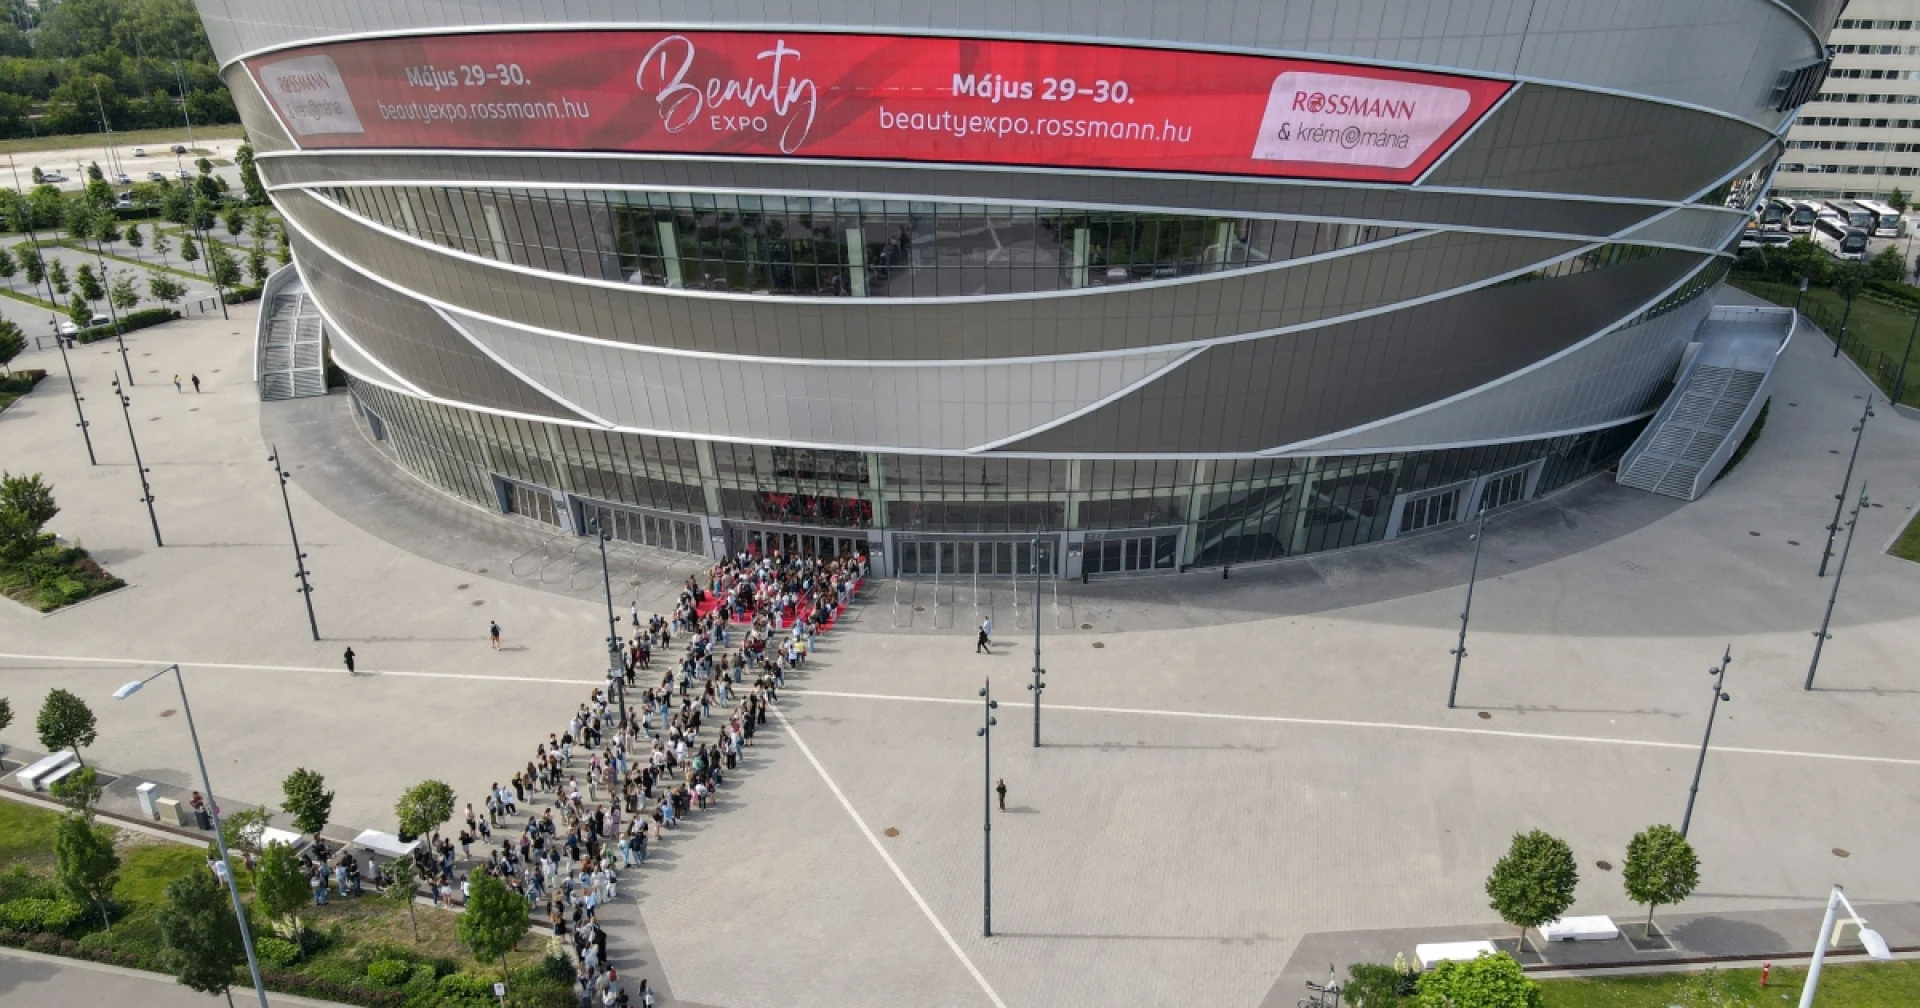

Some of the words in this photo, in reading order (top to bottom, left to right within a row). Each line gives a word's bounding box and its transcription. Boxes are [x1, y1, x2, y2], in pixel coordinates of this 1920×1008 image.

[405, 65, 459, 91] Május
[952, 73, 1033, 104] Május
[1041, 77, 1135, 105] 29–30.
[636, 34, 817, 154] Beauty
[1291, 91, 1417, 121] ROSSMANN
[377, 96, 590, 124] beautyexpo.rossmann.hu
[710, 114, 769, 132] EXPO
[879, 106, 1193, 143] beautyexpo.rossmann.hu
[1277, 122, 1291, 142] &
